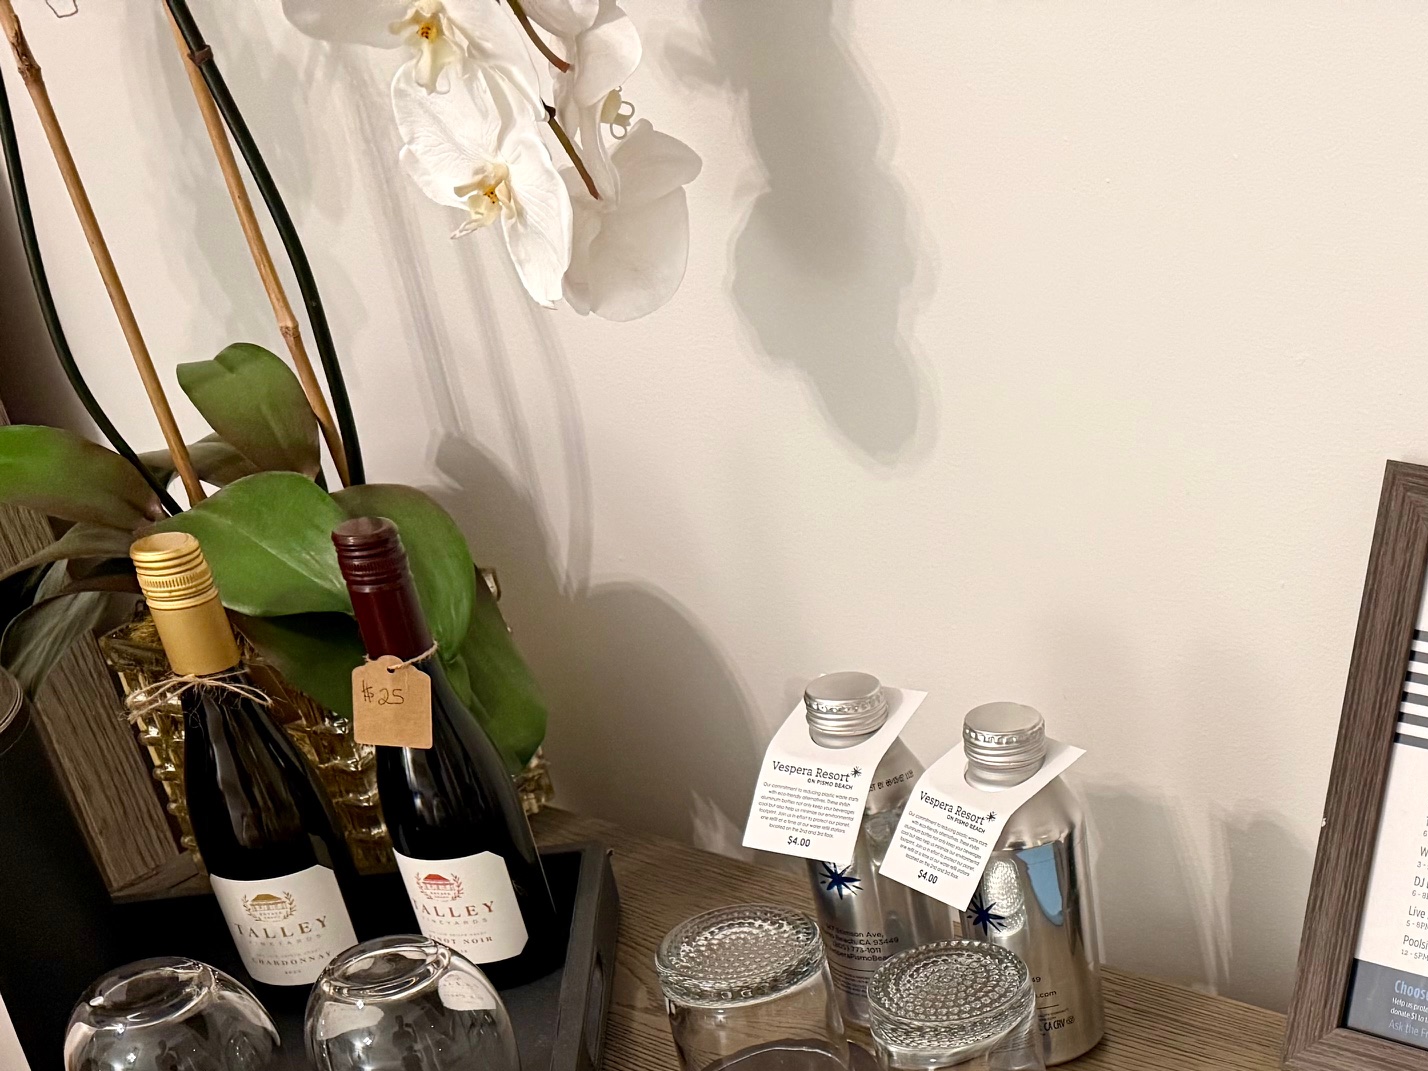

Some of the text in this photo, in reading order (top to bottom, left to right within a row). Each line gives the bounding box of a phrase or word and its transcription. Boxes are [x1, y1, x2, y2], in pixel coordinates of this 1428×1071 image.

[361, 679, 405, 705] $25
[772, 760, 813, 777] Vespera
[815, 767, 850, 783] Resort
[920, 790, 985, 826] Vespera Resort
[787, 835, 811, 848] $4.00
[917, 869, 939, 884] $4.00
[1413, 875, 1426, 888] DJ
[1408, 905, 1426, 919] Live
[234, 915, 327, 939] TALLEY
[873, 936, 899, 945] 93449
[1388, 1019, 1404, 1032] Ask
[1405, 1021, 1419, 1036] the
